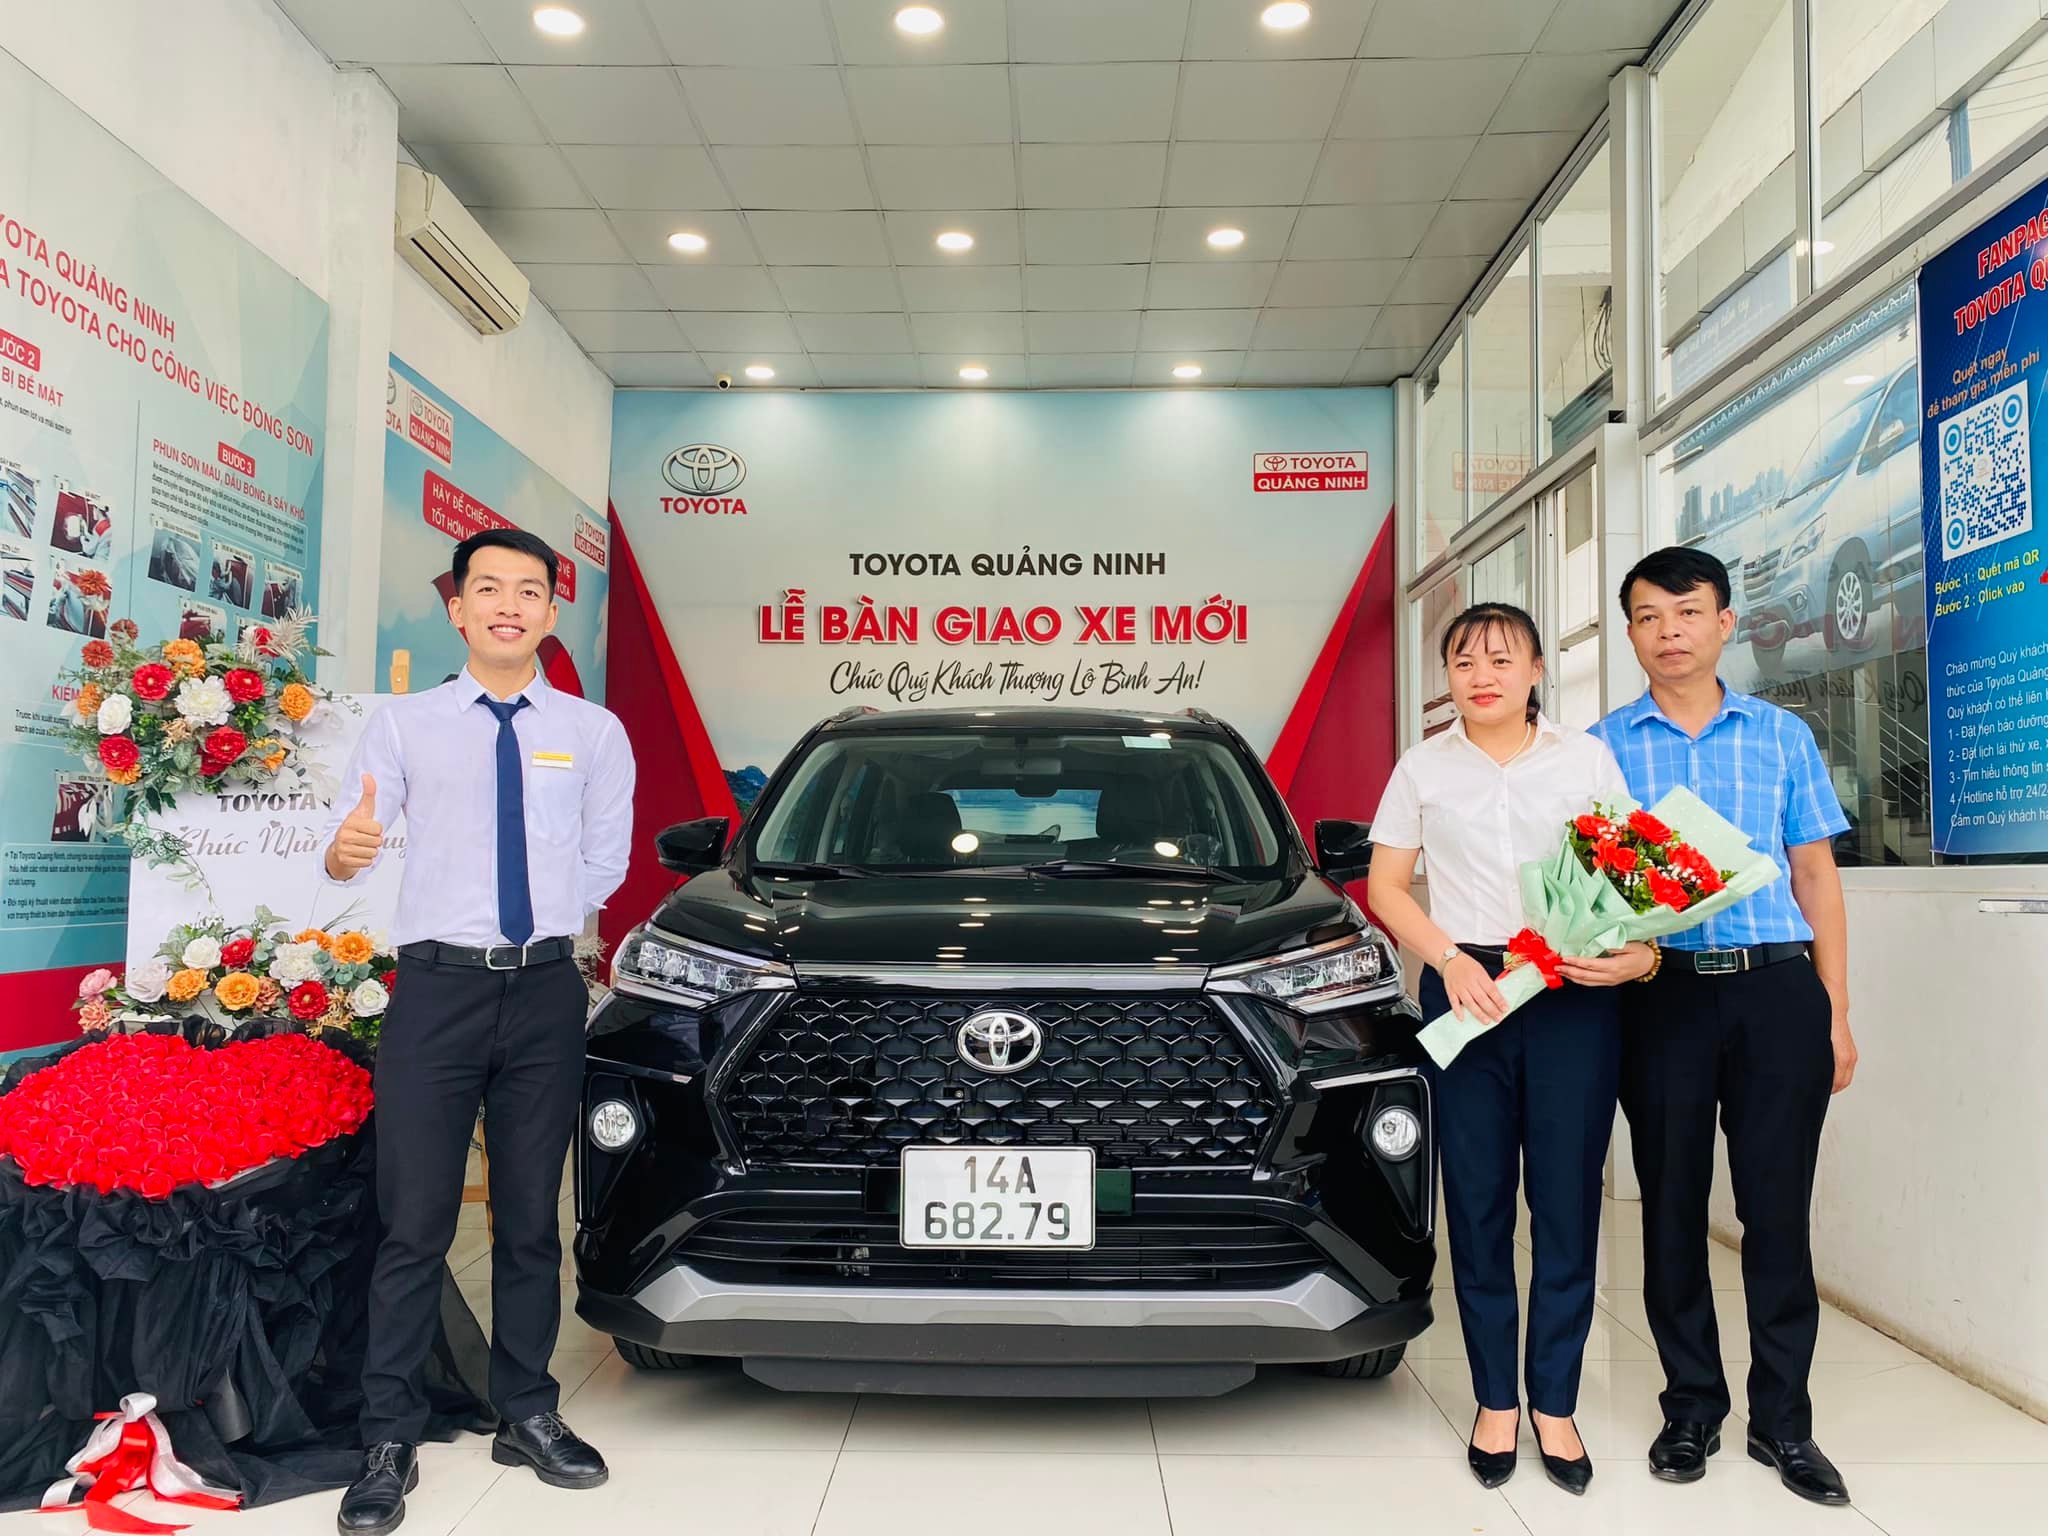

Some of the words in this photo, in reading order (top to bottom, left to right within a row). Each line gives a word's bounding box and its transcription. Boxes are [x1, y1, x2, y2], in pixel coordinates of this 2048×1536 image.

[56, 251, 127, 313] QUẢNG
[133, 297, 175, 343] NINH
[1954, 271, 2026, 335] TOYOTA
[17, 268, 101, 340] TOYOTA
[107, 323, 147, 364] CHO
[152, 349, 200, 394] CÔNG
[205, 377, 239, 415] VIỆC
[286, 425, 313, 457] SƠN
[27, 350, 36, 367] 2
[1953, 361, 1978, 385] Quét
[1980, 348, 2007, 371] ngay
[1942, 388, 1968, 411] tham
[1970, 379, 1987, 399] gia
[1990, 362, 2018, 385] miễn
[410, 422, 436, 449] QUẢNG
[423, 405, 450, 437] TOYOTA
[153, 439, 179, 463] PHUN
[180, 451, 200, 473] SƠN
[222, 448, 247, 471] BƯỚC
[247, 462, 252, 474] 3
[1290, 456, 1356, 469] TOYOTA
[1257, 475, 1320, 490] QUẢNG
[1324, 476, 1366, 489] NINH
[452, 493, 465, 513] ĐỂ
[465, 503, 489, 528] CHIẾC
[660, 497, 748, 514] TOYOTA
[431, 507, 446, 528] TỐT
[447, 516, 464, 539] HƠN
[585, 522, 605, 545] TOYOTA
[576, 534, 605, 564] INSURANCE
[849, 553, 961, 576] TOYOTA
[971, 545, 1083, 577] QUẢNG
[1093, 553, 1166, 575] NINH
[1935, 577, 1961, 595] Bước
[1964, 573, 1969, 585] 1
[1977, 562, 2002, 581] Quét
[2004, 556, 2020, 572] mã
[2023, 549, 2040, 565] QR
[1935, 599, 1961, 617] Bước
[1963, 595, 1970, 608] 2
[2006, 580, 2025, 594] vào
[759, 588, 807, 644] LỄ
[820, 595, 919, 644] BÀN
[933, 605, 1062, 645] GIAO
[1074, 605, 1137, 645] XE
[1152, 593, 1249, 645] MỚI
[1946, 662, 1969, 677] Chào
[1970, 656, 1996, 669] mừng
[1998, 648, 2018, 664] Quý
[830, 660, 883, 694] Chúc
[888, 661, 930, 703] Quý
[931, 659, 996, 696] Khách
[999, 660, 1065, 702] Thượng
[1099, 659, 1151, 695] Bình
[1153, 659, 1206, 695] An!
[1946, 684, 1966, 697] thức
[1967, 680, 1984, 693] của
[1985, 673, 2015, 691] Toyota
[1947, 702, 1965, 720] Quý
[1967, 699, 1993, 715] khách
[1995, 696, 2006, 710] có
[2008, 690, 2024, 708] thể
[2026, 690, 2043, 705] liên
[1948, 728, 1953, 740] 1
[1961, 725, 1977, 739] Đặt
[1979, 722, 1995, 737] hẹn
[1997, 717, 2015, 732] bảo
[1948, 749, 1954, 762] 2
[1961, 746, 1978, 761] Đặt
[1979, 745, 1994, 760] lịch
[1996, 742, 2007, 755] lái
[2009, 738, 2026, 752] thử
[1948, 771, 1955, 784] 3
[1981, 763, 2000, 779] hiểu
[2002, 763, 2029, 778] thông
[2031, 761, 2043, 774] tin
[217, 793, 317, 812] TOYOTA
[1949, 793, 1956, 805] 4
[1963, 790, 1994, 804] Hotline
[1996, 784, 2008, 801] hỗ
[2010, 787, 2024, 802] trợ
[1951, 812, 1971, 827] Cảm
[1972, 814, 1985, 825] ơn
[1987, 810, 2006, 827] Quý
[2008, 808, 2037, 823] khách
[963, 1155, 1037, 1194] 14A
[924, 1201, 1071, 1241] 682.79
